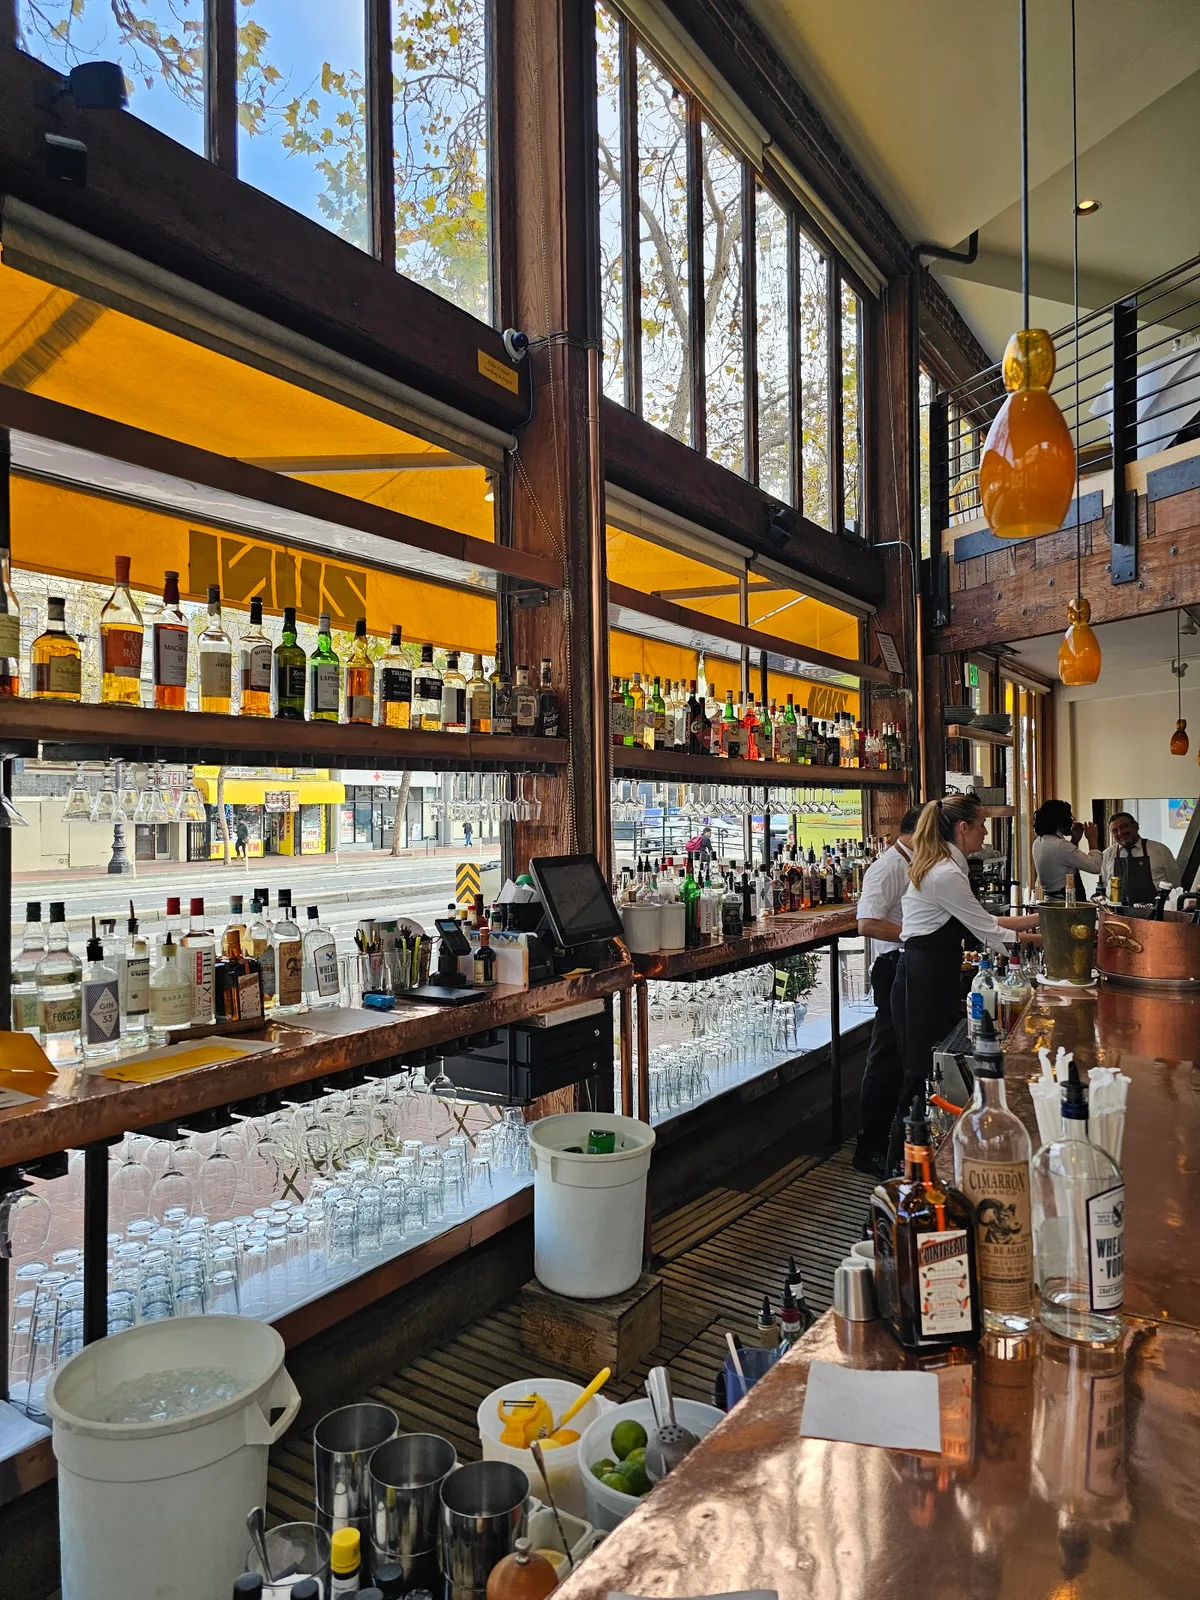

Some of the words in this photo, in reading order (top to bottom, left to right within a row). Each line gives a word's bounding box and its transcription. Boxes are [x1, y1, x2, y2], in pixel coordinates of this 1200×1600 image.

[156, 771, 184, 785] HTEL
[302, 841, 320, 850] DELI
[319, 963, 338, 975] WHEATL
[99, 1002, 114, 1010] GIN
[53, 1010, 77, 1023] FORDS
[102, 1014, 113, 1024] 33
[968, 1170, 1026, 1193] CIMARRON
[1106, 1258, 1124, 1279] VOD
